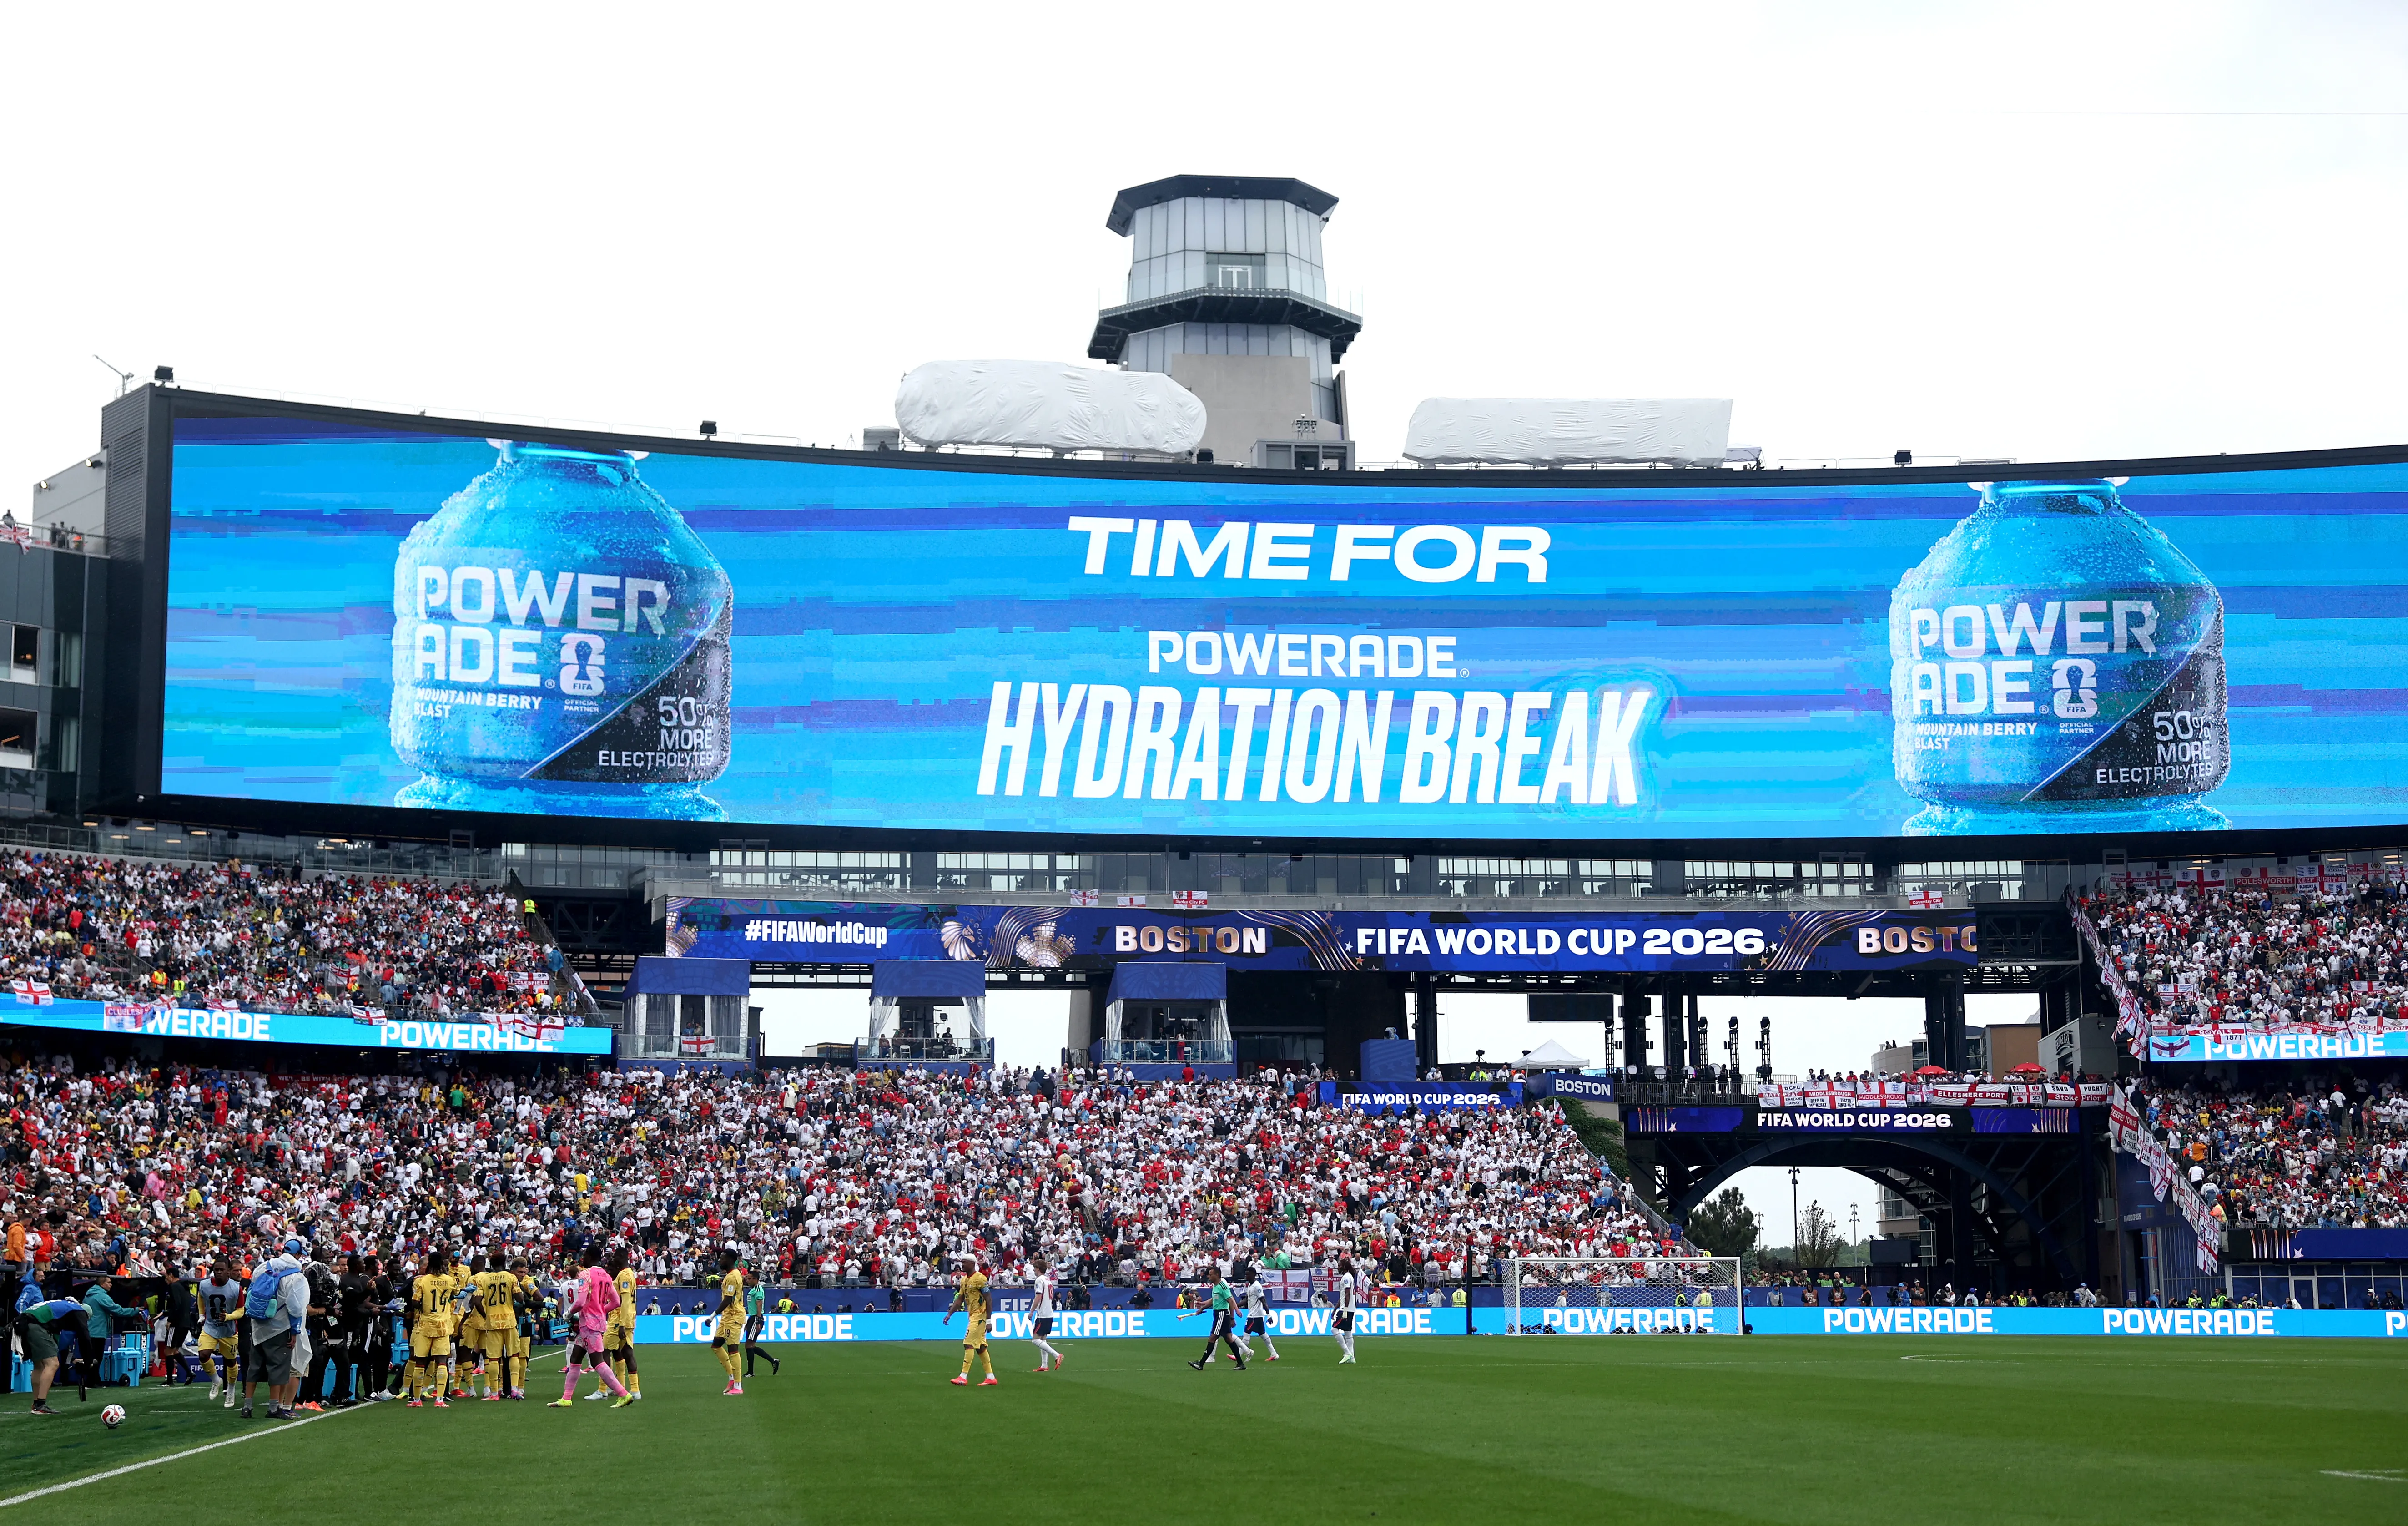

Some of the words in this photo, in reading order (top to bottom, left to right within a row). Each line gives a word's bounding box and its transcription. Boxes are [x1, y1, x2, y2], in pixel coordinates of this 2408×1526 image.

[1067, 516, 1315, 580] TIME
[1330, 524, 1552, 584] FOR
[416, 565, 671, 636] POWER
[1910, 600, 2157, 660] POWER
[414, 624, 541, 687] ADE
[1148, 630, 1456, 678] POWERADE
[572, 682, 593, 691] FIFA
[1912, 660, 2035, 715] ADE
[416, 687, 482, 707] MOUNTAIN
[485, 692, 542, 710] BERRY
[564, 705, 599, 713] PARTNER
[414, 704, 451, 718] BLAST
[659, 728, 713, 750] MORE
[1916, 723, 1979, 737] MOUNTAIN
[1982, 722, 2037, 736] BERRY
[977, 681, 1394, 803] HYDRATION
[1399, 689, 1652, 805] BREAK
[1914, 738, 1950, 750] BLAST
[2157, 742, 2211, 764] MORE
[598, 751, 715, 768] ELECTROLYTES
[2096, 762, 2214, 784] ELECTROLYTES
[745, 920, 887, 949] #FIFAWorldCup
[1115, 925, 1267, 954] BOSTON
[1357, 928, 1430, 955] FIFA
[1435, 928, 1561, 955] WORLD
[1567, 928, 1637, 955] CUP
[1643, 928, 1765, 955] 2026
[145, 1008, 272, 1041] WERADE
[1342, 1094, 1370, 1104] FIFA
[1374, 1094, 1422, 1104] WORLD
[1424, 1094, 1451, 1104] CUP
[1453, 1094, 1500, 1104] 2026
[1555, 1079, 1611, 1096] BOSTON
[1758, 1113, 1793, 1127] FIFA
[1794, 1113, 1855, 1127] WORLD
[1858, 1113, 1890, 1127] CUP
[1894, 1113, 1951, 1127] 2026
[430, 1288, 448, 1313] 14
[489, 1281, 506, 1306] 26
[567, 1288, 574, 1304] 9
[1001, 1299, 1036, 1311] FIF
[1543, 1309, 1713, 1333] POWERADE
[1824, 1308, 1993, 1332] POWERADE
[2103, 1309, 2274, 1334] POWERADE
[725, 1329, 730, 1337] 19
[230, 1344, 237, 1353] 10
